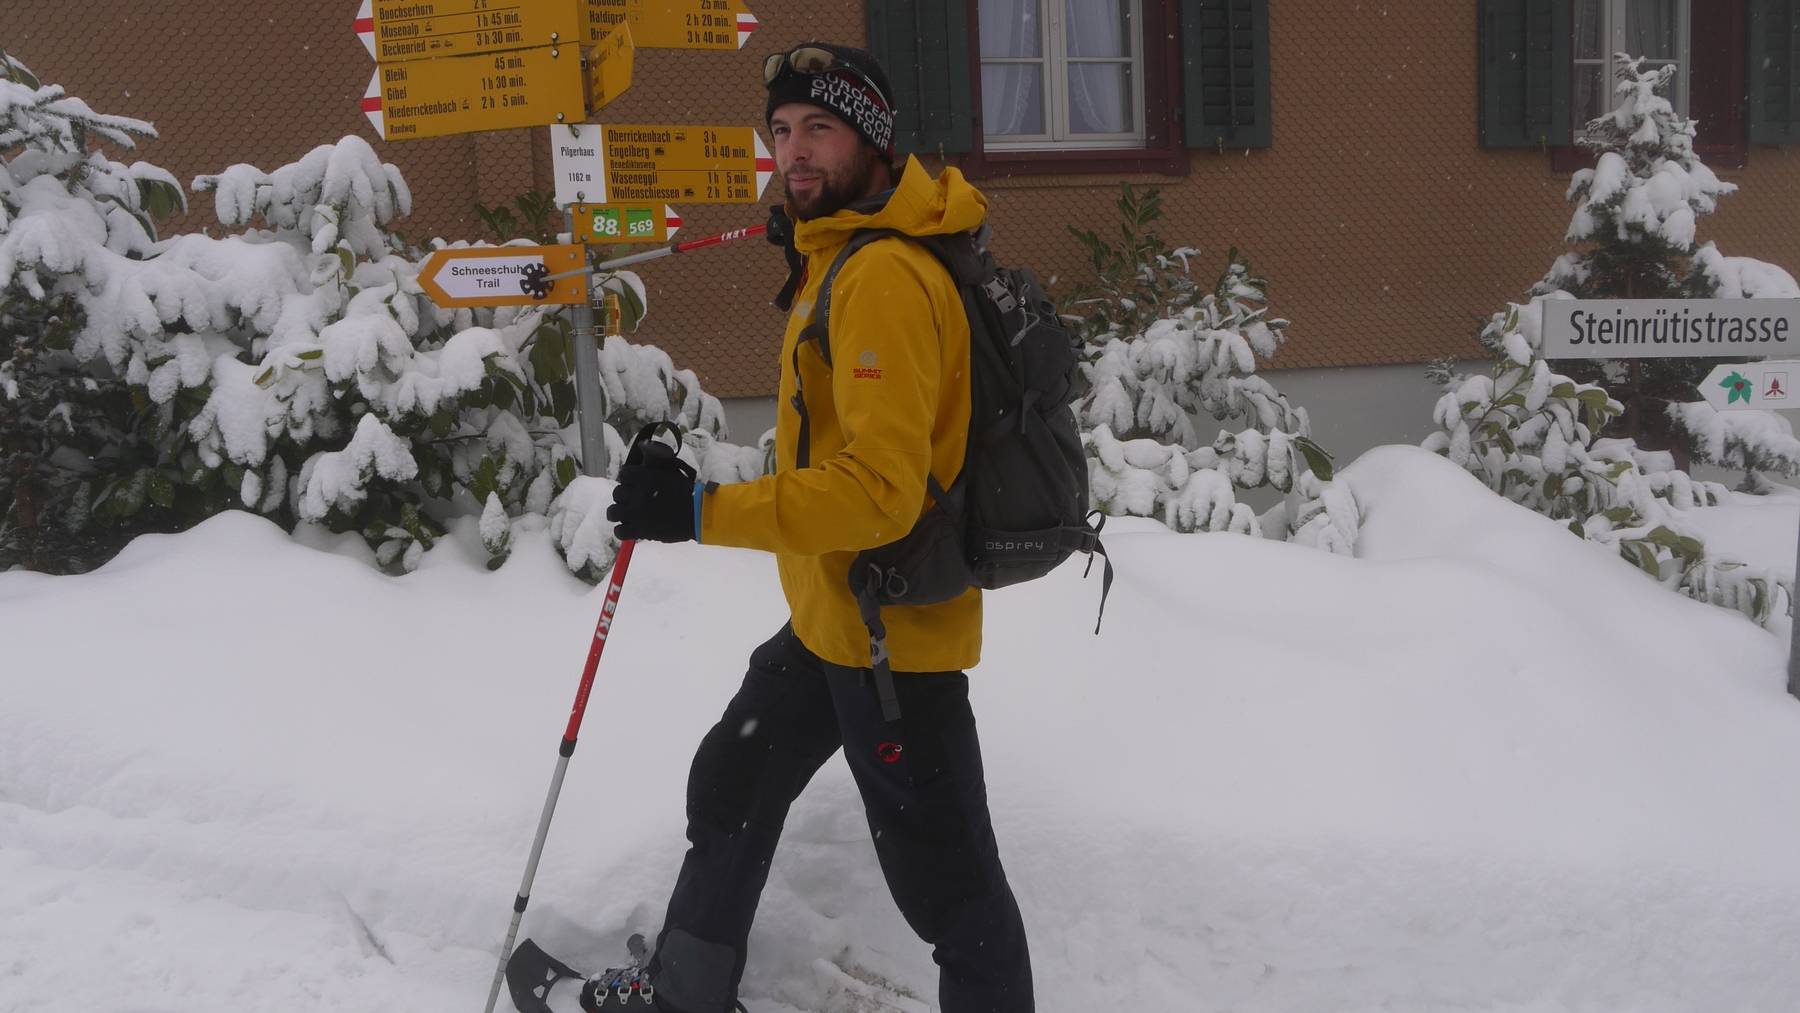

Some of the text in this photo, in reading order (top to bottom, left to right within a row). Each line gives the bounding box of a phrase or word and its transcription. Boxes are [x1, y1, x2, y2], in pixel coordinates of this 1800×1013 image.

[713, 0, 730, 10] min.
[381, 12, 522, 38] Musenalp 1 h 45 min.
[686, 14, 691, 26] 2
[694, 14, 699, 26] h
[702, 14, 713, 26] 20
[715, 15, 732, 27] min.
[382, 30, 524, 57] Beckenried 3 h 30 min.
[590, 28, 732, 44] Bris 3 h 40 min.
[385, 56, 526, 82] Bleiki 45 min.
[387, 74, 527, 101] Gibel 1 h 30 min.
[388, 94, 528, 118] Niederrickenbach 2 h 5 min.
[825, 72, 894, 128] UROPEAN
[811, 78, 893, 139] OUTDOOR
[810, 88, 890, 151] FILM TOUR
[607, 129, 717, 144] Oberrickenbach 3 h
[560, 146, 595, 158] Pilgerhaus
[609, 144, 749, 159] Engelberg 8 h 40 min.
[568, 172, 592, 183] 1162 m
[611, 171, 751, 186] Waseneggli 1 h 5 min.
[612, 186, 752, 200] Wolfenschiessen 2 h 5 min.
[629, 219, 653, 235] 569
[476, 278, 500, 289] Trail
[1569, 308, 1789, 346] Steinrütistrasse
[985, 541, 1044, 552] osprey
[596, 583, 622, 641] LEKI
